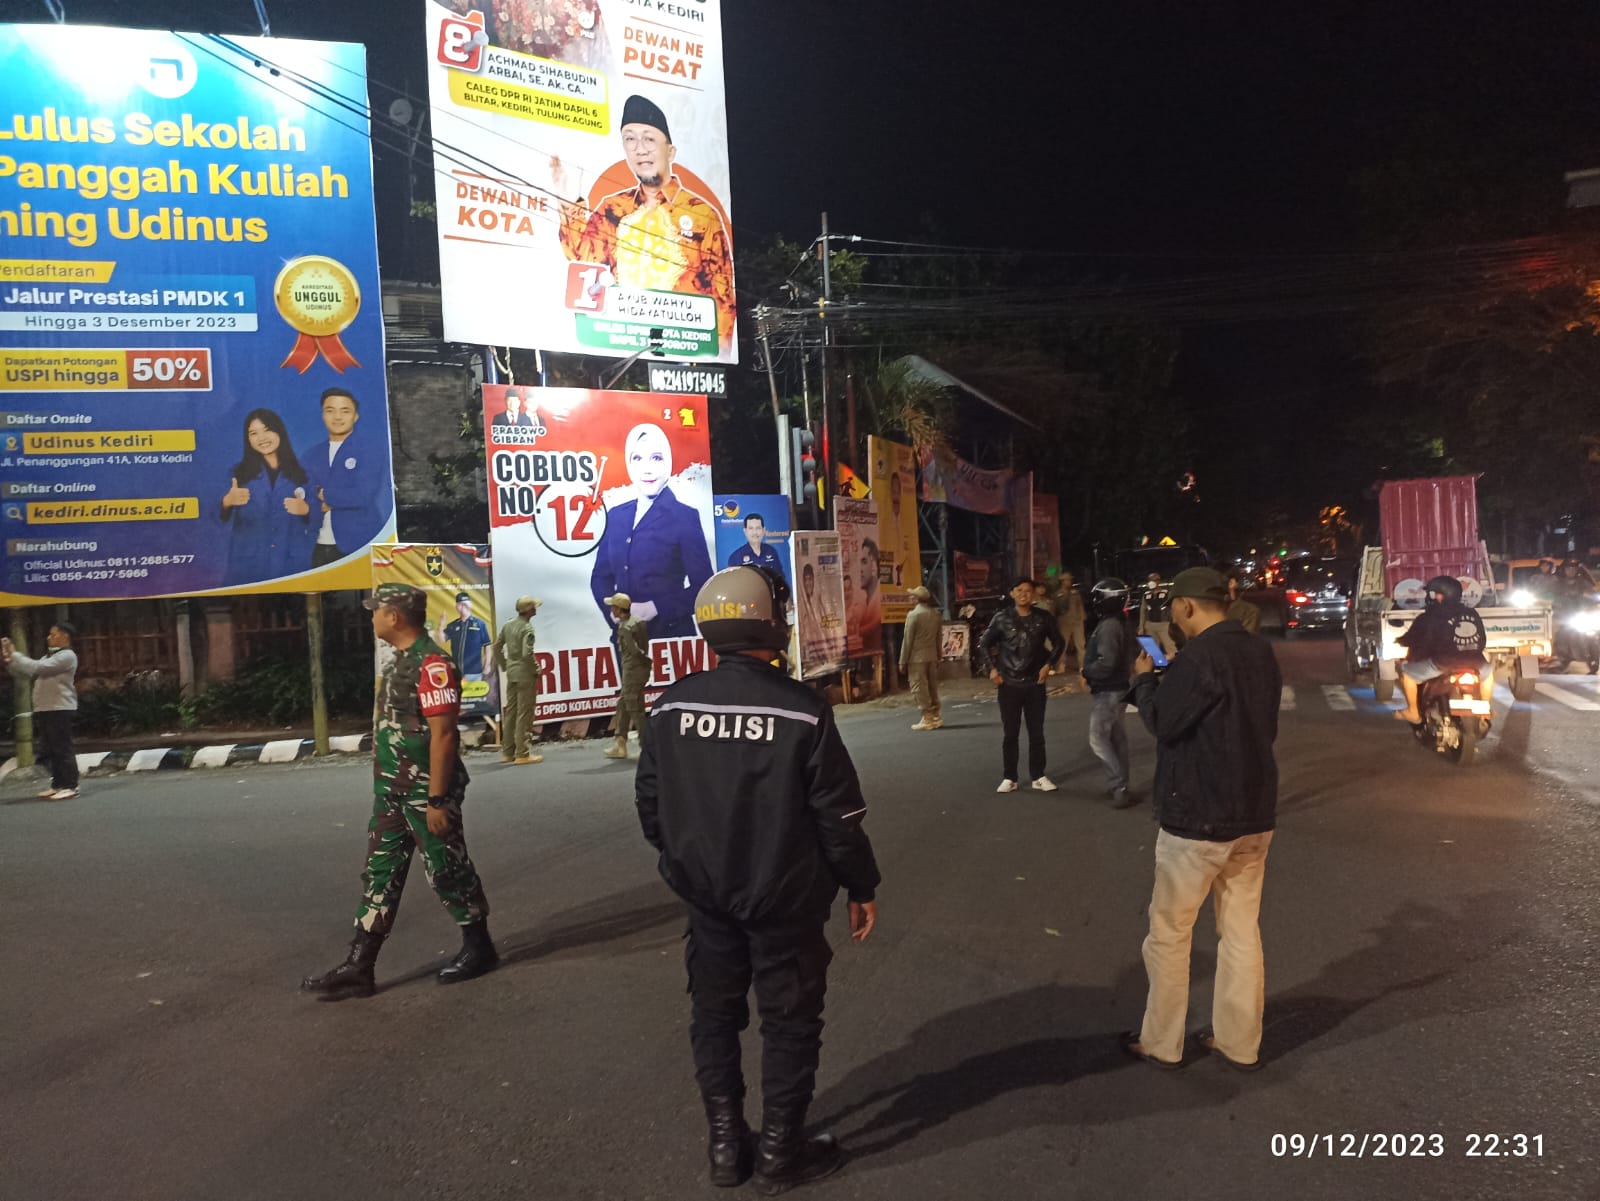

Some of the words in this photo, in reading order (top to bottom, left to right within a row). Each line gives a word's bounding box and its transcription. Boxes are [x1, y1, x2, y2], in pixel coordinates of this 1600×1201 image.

[657, 1, 704, 22] KEDIRI
[444, 24, 472, 62] 8
[624, 26, 680, 52] DEWAN
[685, 42, 704, 58] NE
[488, 53, 536, 72] ACHMAD
[539, 65, 597, 86] SIHABUDIN
[624, 46, 702, 80] PUSAT
[488, 66, 526, 83] ARBAI,
[567, 83, 585, 95] CA.
[466, 81, 498, 96] CALEG
[500, 88, 520, 100] DPR
[523, 93, 532, 103] RI
[534, 95, 561, 109] JATIM
[563, 102, 589, 116] DAPIL
[592, 108, 598, 117] 6
[536, 107, 570, 122] TULUNG
[572, 114, 603, 129] AGUNG
[124, 112, 307, 152] Sekolah
[208, 163, 349, 198] Kuliah
[456, 182, 520, 209] DEWAN
[525, 194, 548, 213] NE
[107, 206, 269, 243] Udinus
[457, 206, 534, 236] KOTA
[0, 264, 95, 278] endaftaran
[4, 287, 65, 305] Jalur
[69, 289, 159, 306] Prestasi
[163, 290, 229, 307] PMDK
[234, 291, 244, 306] 1
[295, 292, 342, 302] UNGGUL
[653, 297, 692, 310] WAHYU
[25, 316, 87, 330] Hingga
[93, 317, 102, 328] 3
[108, 316, 190, 328] Desember
[196, 317, 237, 328] 2023
[5, 357, 60, 367] Dapatkan
[63, 357, 117, 367] Potongan
[132, 356, 202, 382] 50%
[6, 369, 49, 382] USPI
[54, 369, 119, 385] hingga
[7, 414, 47, 425] Daftar
[50, 413, 93, 424] Onsite
[664, 408, 672, 420] 2
[491, 425, 546, 437] PRABOWO
[492, 435, 535, 445] GIBRAN
[31, 436, 95, 449] Udinus
[101, 435, 153, 447] Kediri
[17, 456, 105, 469] Penanggungan
[134, 455, 159, 465] Kota
[161, 454, 193, 464] Kediri
[495, 453, 594, 482] COBLOS
[10, 484, 51, 494] Daftar
[54, 482, 96, 492] Online
[34, 502, 186, 519] kediri.dinus.ac.id
[499, 486, 541, 514] NO.
[714, 504, 723, 517] 5
[547, 494, 594, 541] 12
[16, 540, 98, 552] Narahubung
[534, 646, 618, 695] RITA
[543, 703, 567, 716] DPRD
[569, 701, 591, 713] KOTA
[679, 712, 775, 741] POLISI
